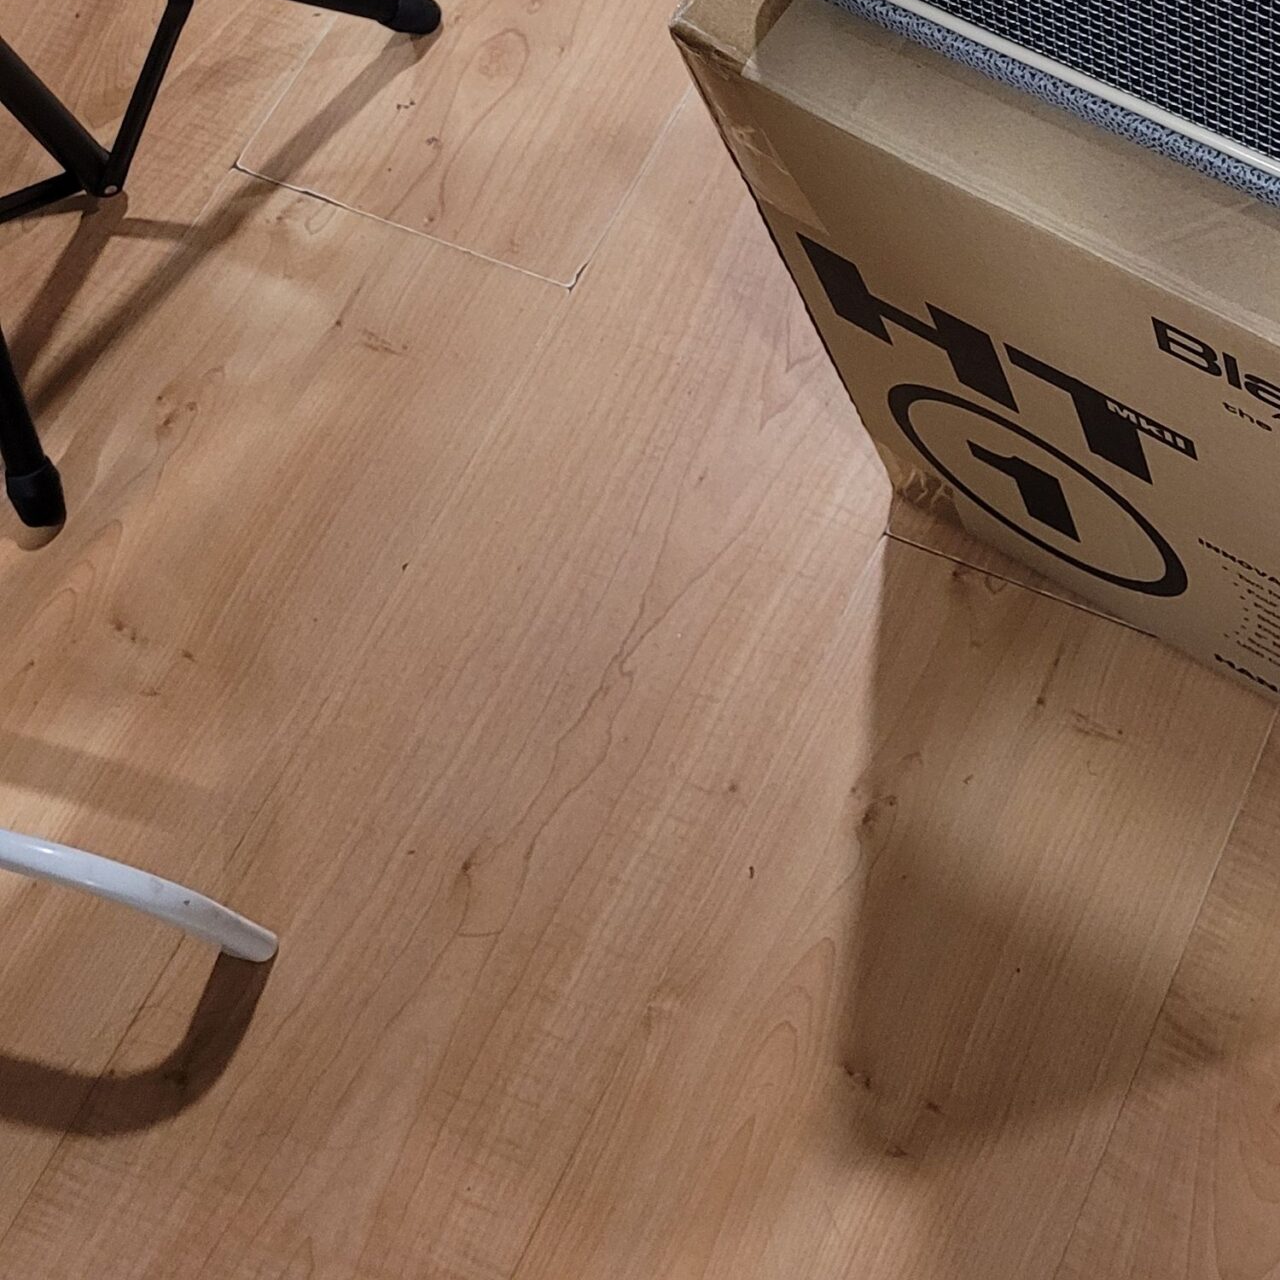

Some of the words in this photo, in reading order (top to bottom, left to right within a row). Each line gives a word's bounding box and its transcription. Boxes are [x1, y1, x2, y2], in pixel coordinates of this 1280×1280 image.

[795, 231, 1198, 485] HT
[1106, 399, 1191, 452] MkII
[1222, 401, 1273, 432] the
[966, 438, 1082, 544] 1
